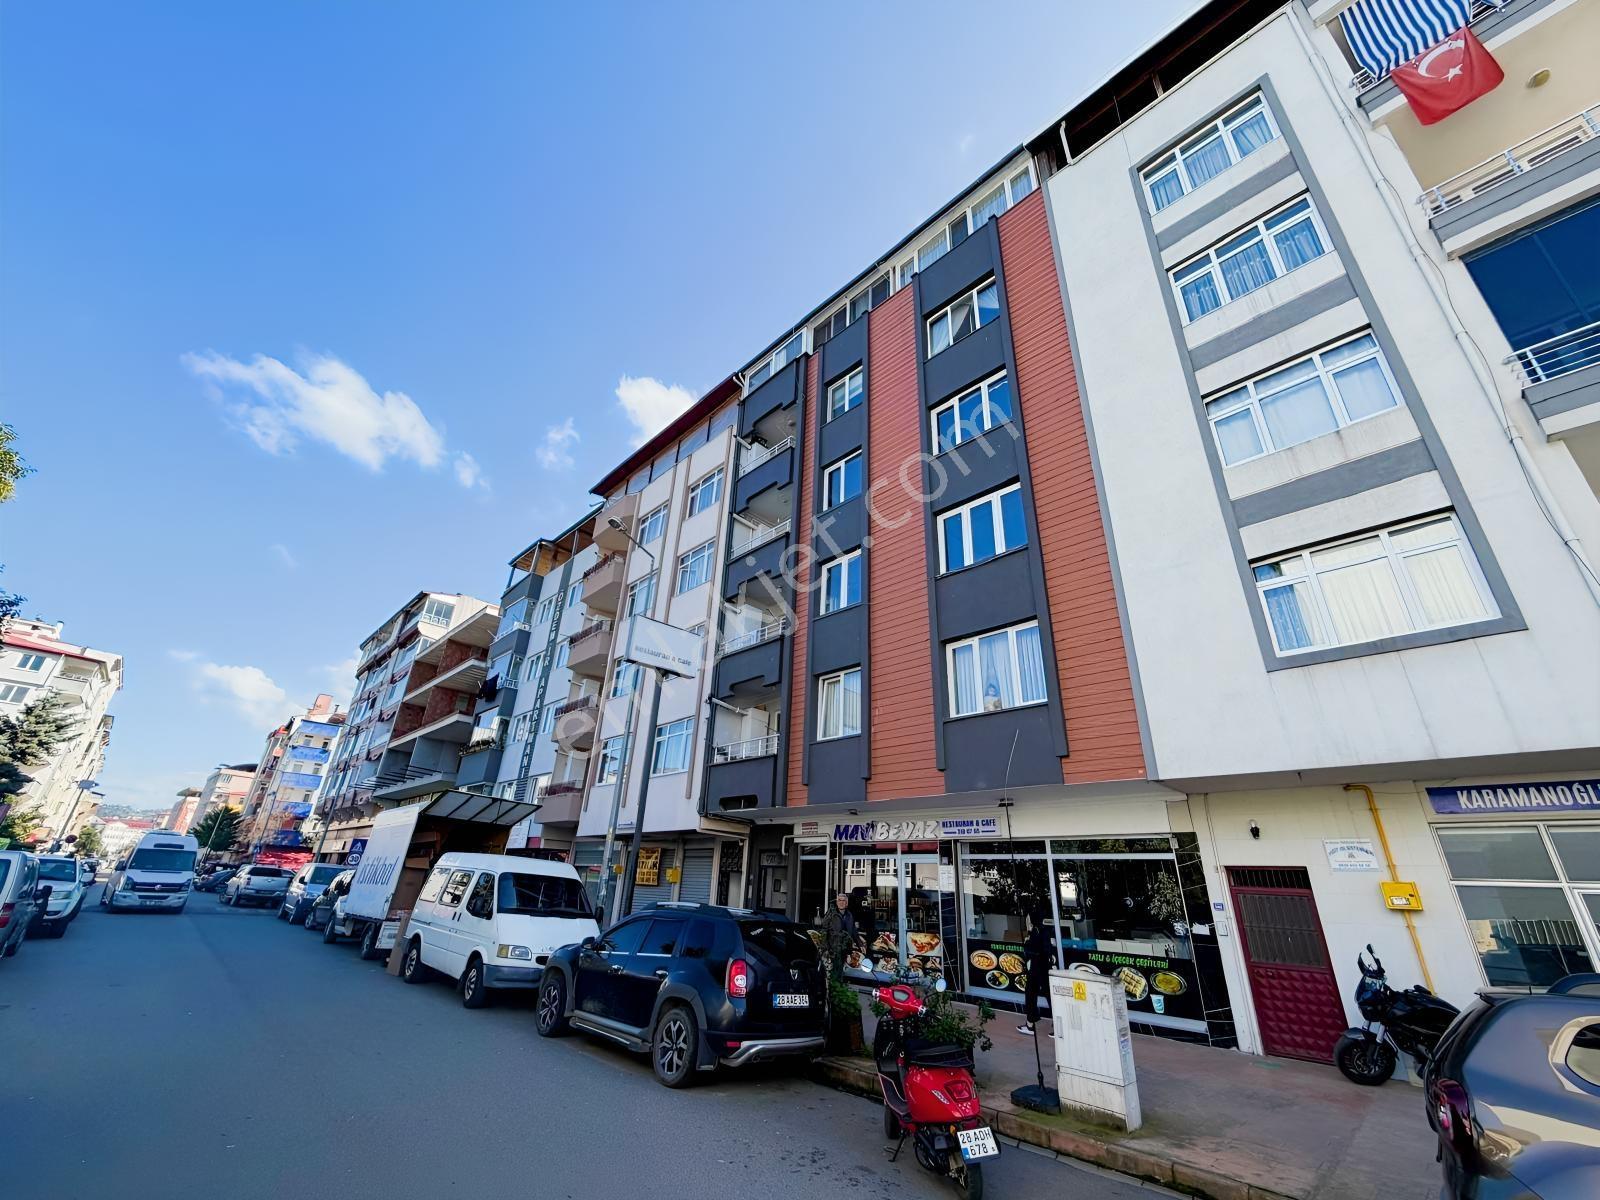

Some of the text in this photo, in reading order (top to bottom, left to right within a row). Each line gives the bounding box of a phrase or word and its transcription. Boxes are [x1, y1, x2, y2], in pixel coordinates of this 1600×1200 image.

[981, 818, 997, 827] CAFE
[875, 819, 939, 841] BEYAZ
[960, 1132, 973, 1144] 28
[969, 1143, 989, 1156] 678
